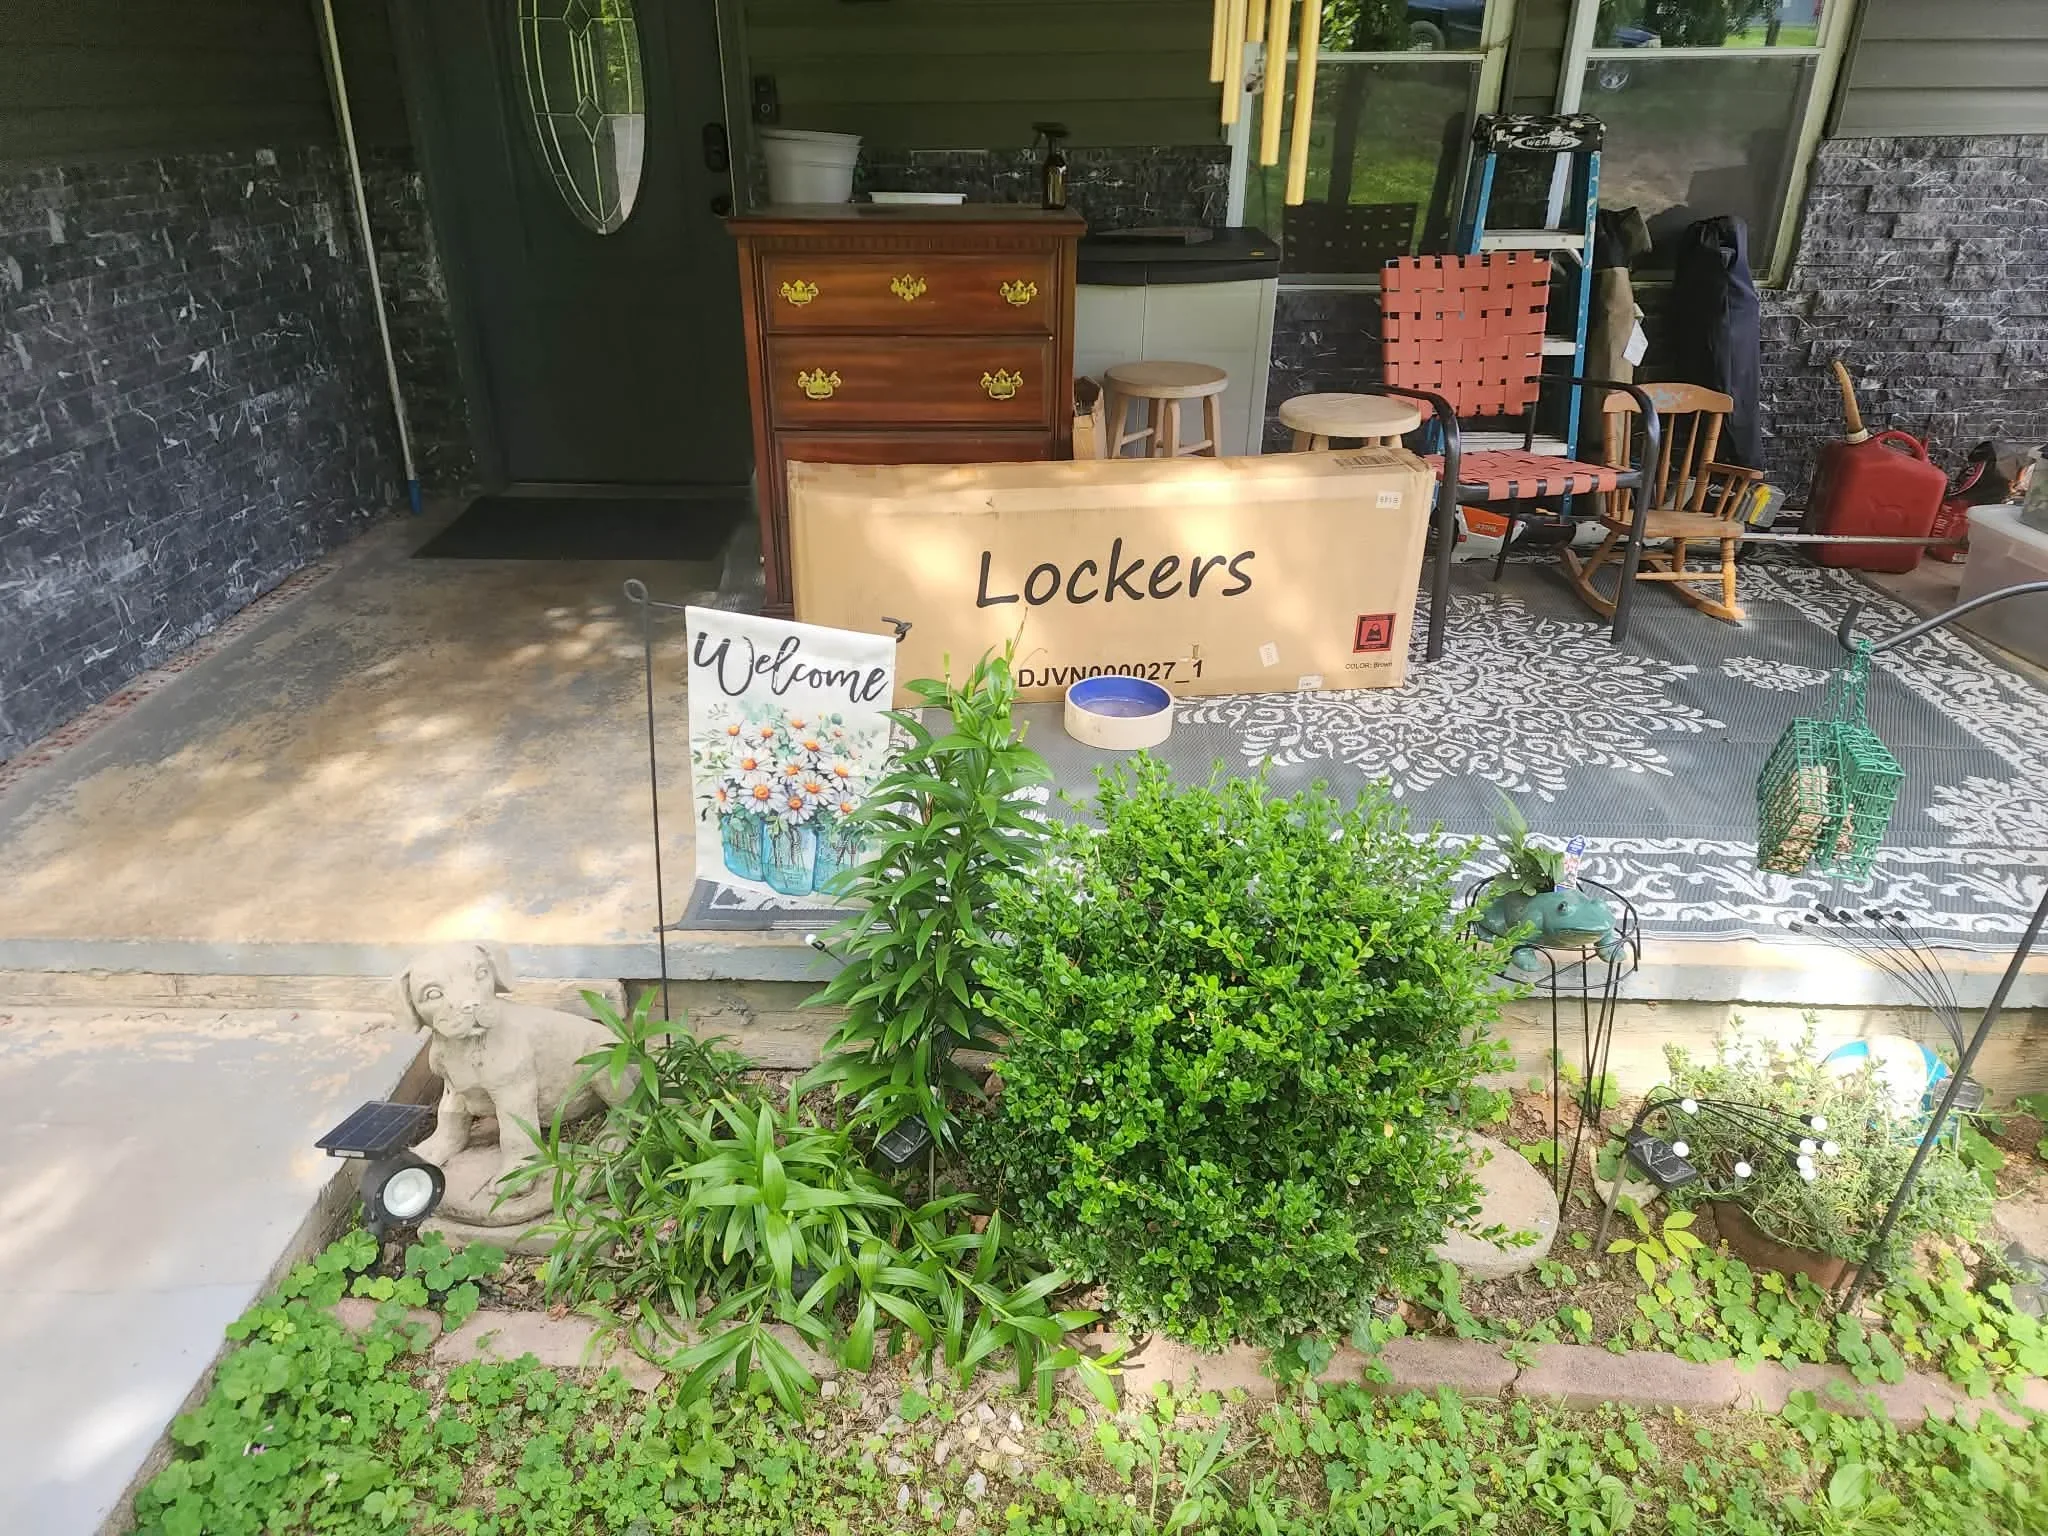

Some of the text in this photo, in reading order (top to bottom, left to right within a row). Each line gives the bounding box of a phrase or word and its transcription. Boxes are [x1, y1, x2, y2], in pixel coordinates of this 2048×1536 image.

[976, 537, 1256, 608] Lockers
[693, 631, 888, 703] Welcome
[1345, 662, 1372, 670] COLOR:
